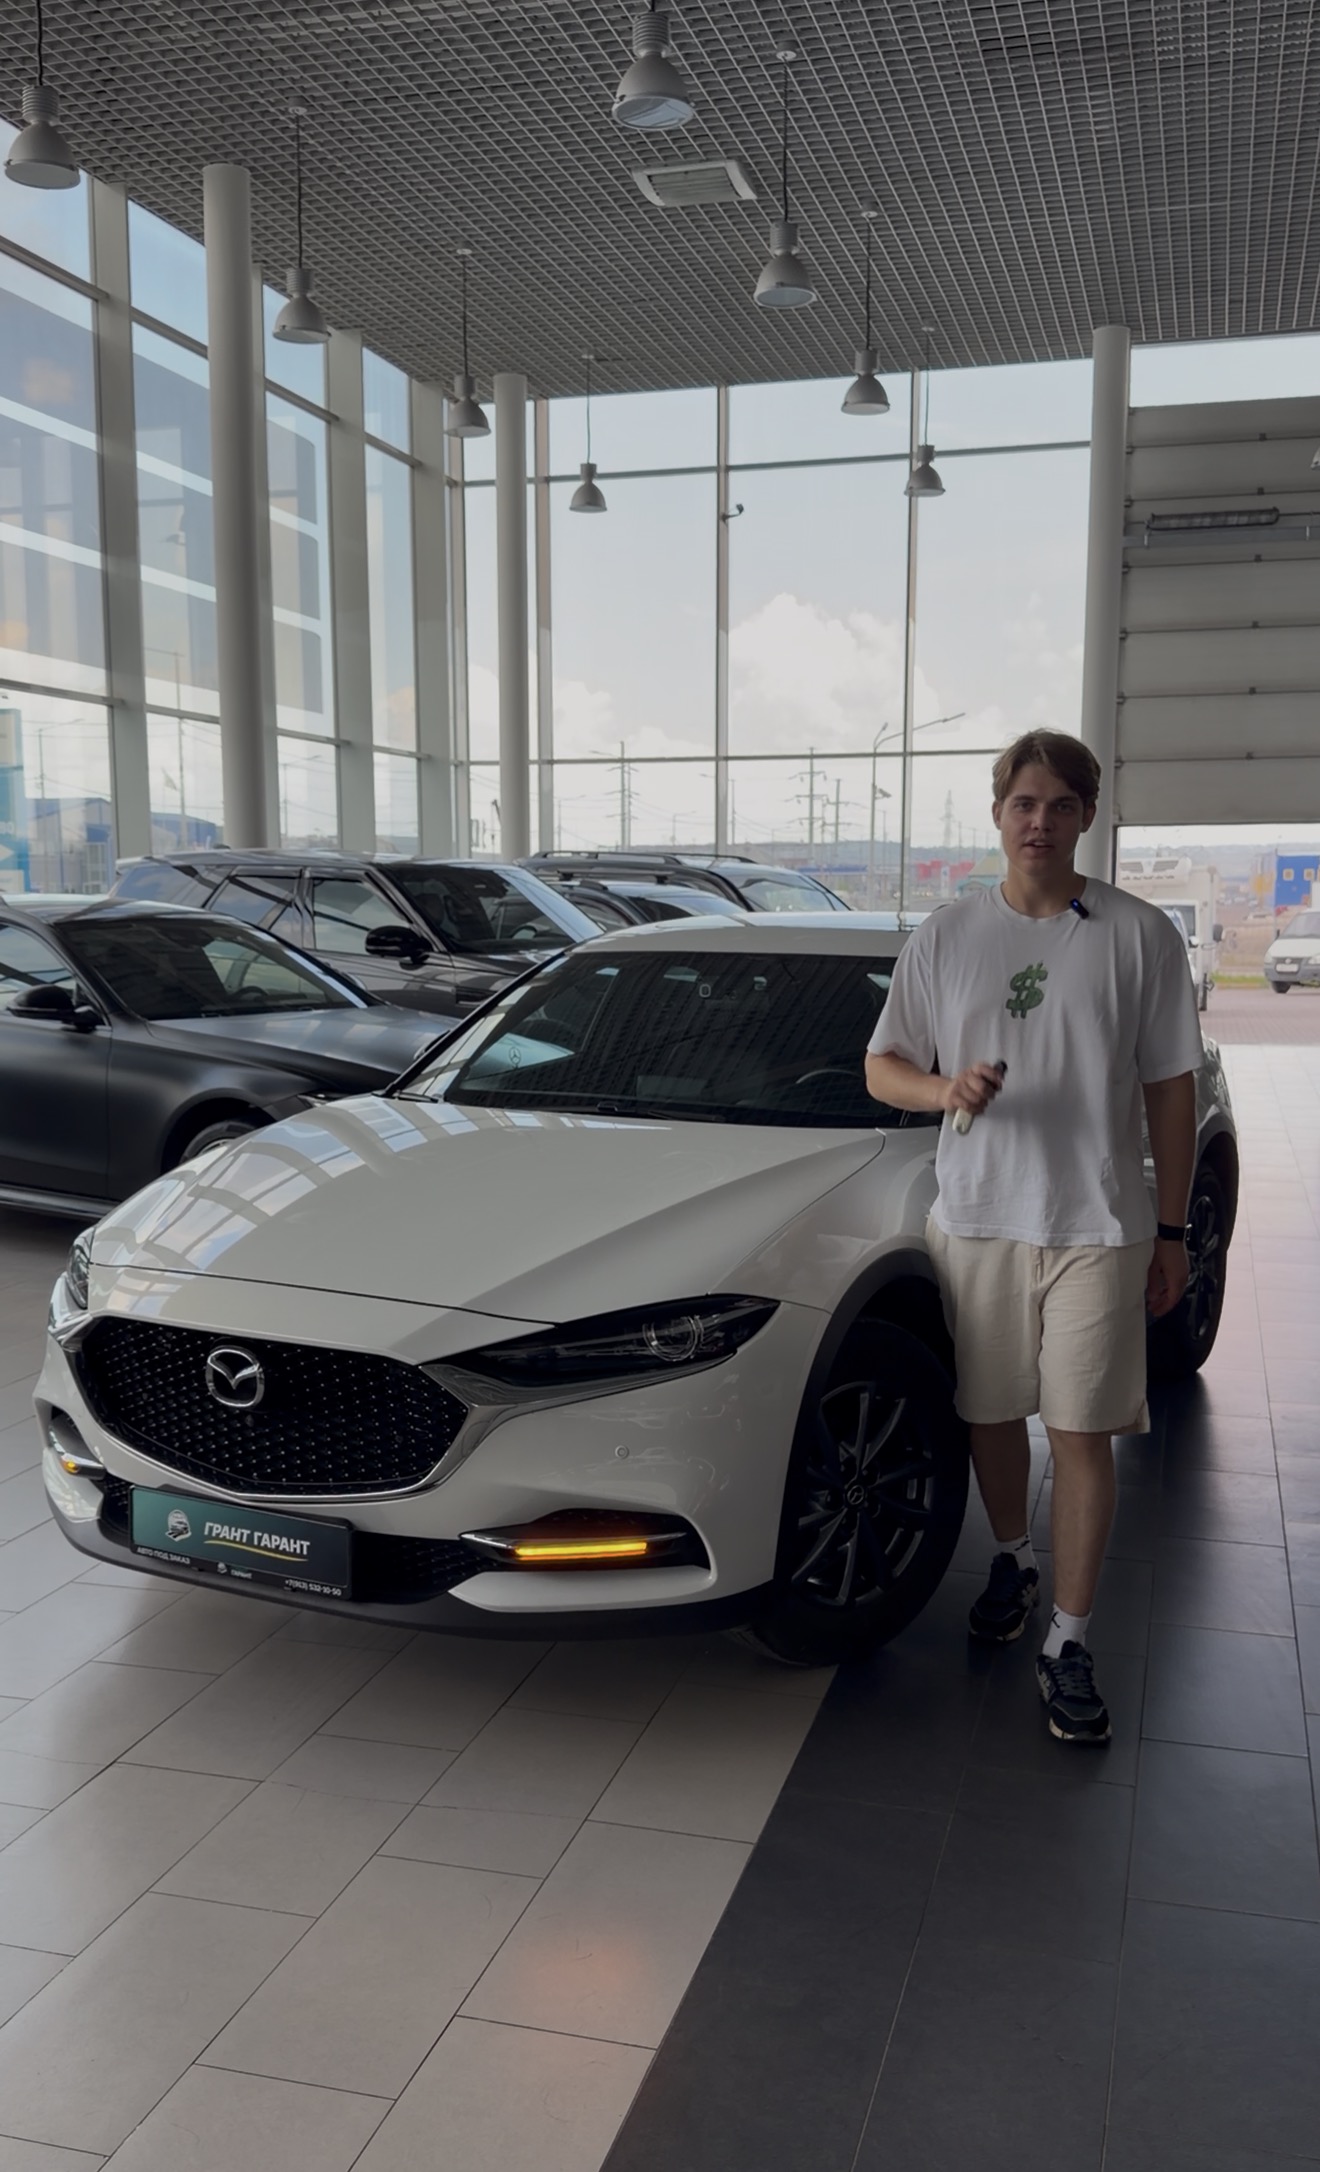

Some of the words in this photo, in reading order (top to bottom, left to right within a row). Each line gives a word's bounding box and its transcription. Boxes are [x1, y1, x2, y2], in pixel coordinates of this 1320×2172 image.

[204, 1522, 250, 1543] ГРАНТ
[253, 1532, 310, 1555] ГАРАНТ
[137, 1547, 154, 1557] АВТО
[154, 1550, 168, 1560] ПОД
[169, 1553, 191, 1564] ЗАКАЗ
